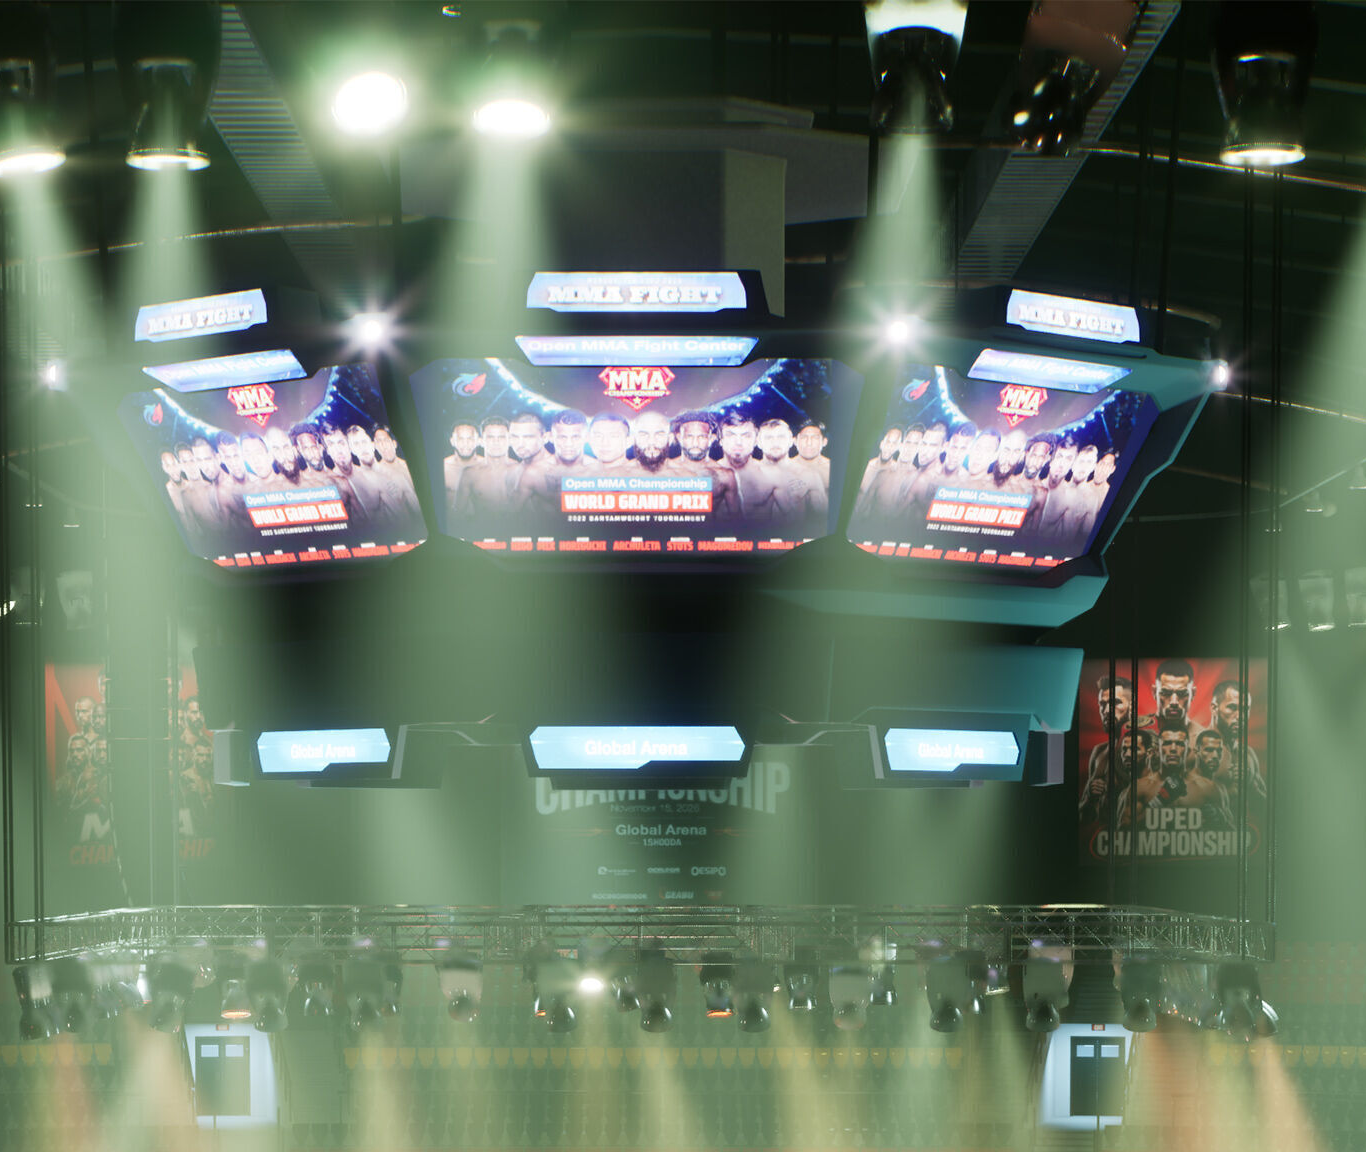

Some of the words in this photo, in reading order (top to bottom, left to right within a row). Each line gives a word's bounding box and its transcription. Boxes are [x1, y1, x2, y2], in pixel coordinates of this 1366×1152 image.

[548, 286, 624, 304] MMA
[629, 286, 722, 304] FIGHT
[148, 311, 194, 335] MMA
[196, 304, 253, 328] FIGHT
[1018, 304, 1066, 327] MMA
[1067, 311, 1125, 336] FIGHT
[528, 339, 576, 353] Open
[581, 340, 629, 351] MMA
[634, 339, 678, 353] Fight
[684, 339, 747, 351] Center
[608, 371, 667, 391] MMA
[232, 388, 275, 410] MMA
[1002, 388, 1041, 411] MMA
[565, 479, 595, 489] Open
[597, 479, 627, 488] MMA
[629, 478, 708, 489] Championship
[266, 493, 286, 503] MMA
[564, 494, 615, 510] WORLD
[618, 494, 669, 510] GRAND
[672, 494, 709, 510] PRIX
[958, 489, 978, 500] MMA
[250, 508, 287, 525] WORLD
[284, 505, 320, 522] GRAND
[318, 503, 346, 519] PRIX
[929, 503, 966, 520] WORLD
[964, 506, 999, 523] GRAND
[997, 508, 1024, 525] PRIX
[290, 743, 323, 759] Global
[324, 743, 356, 759] Arena
[585, 740, 636, 755] Global
[640, 740, 689, 755] Arena
[917, 743, 952, 758] Global
[953, 743, 985, 759] Arena
[1146, 807, 1202, 829] UPED
[615, 824, 662, 836] Global
[666, 824, 707, 836] Arena
